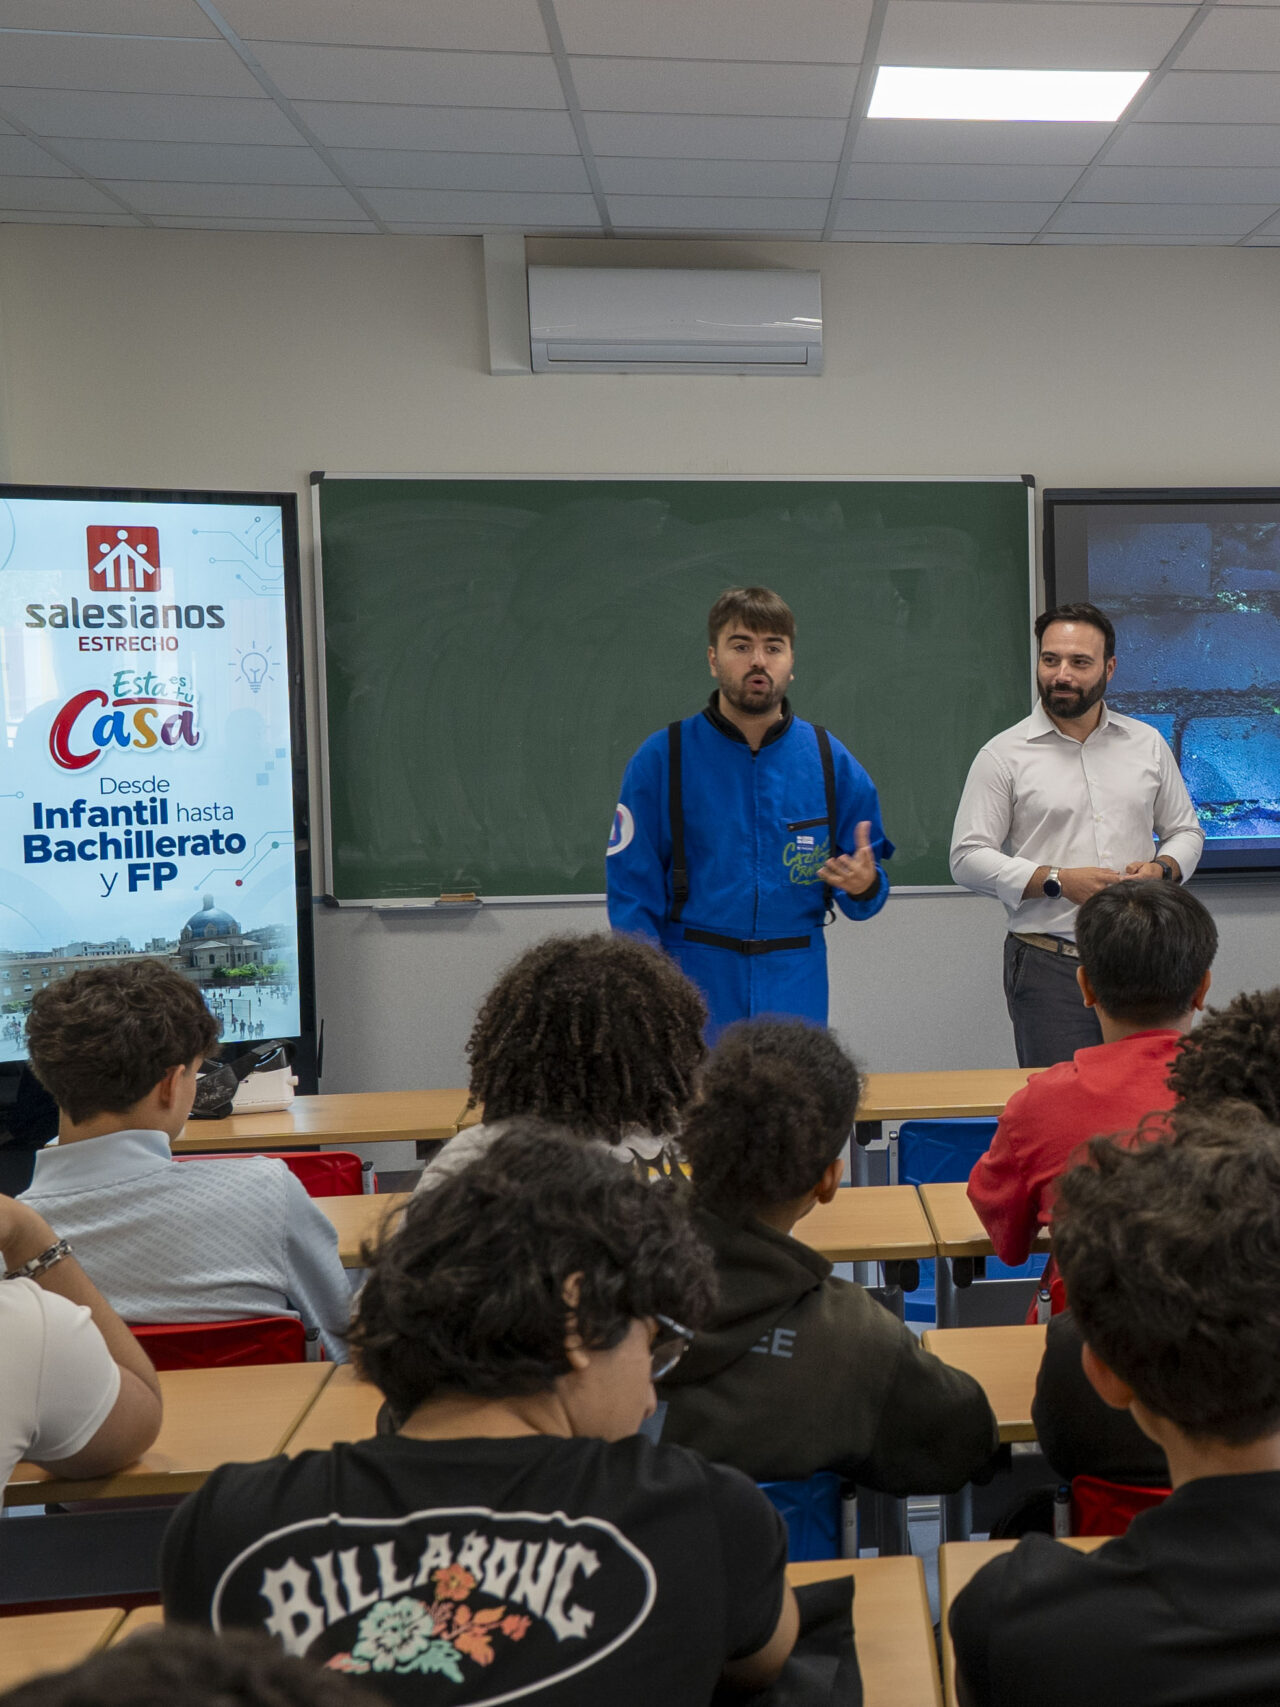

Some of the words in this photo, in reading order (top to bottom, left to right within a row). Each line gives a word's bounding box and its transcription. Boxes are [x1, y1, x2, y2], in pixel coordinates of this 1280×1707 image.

[25, 596, 225, 629] salesianos
[78, 636, 179, 651] ESTRECHO
[112, 669, 168, 698] Esta
[169, 676, 187, 687] es
[49, 689, 200, 770] Casa
[100, 776, 170, 795] Desde
[33, 797, 168, 829] Infantil
[176, 801, 234, 822] hasta
[23, 829, 246, 864] Bachillerato
[100, 872, 118, 898] y
[128, 861, 179, 892] FP
